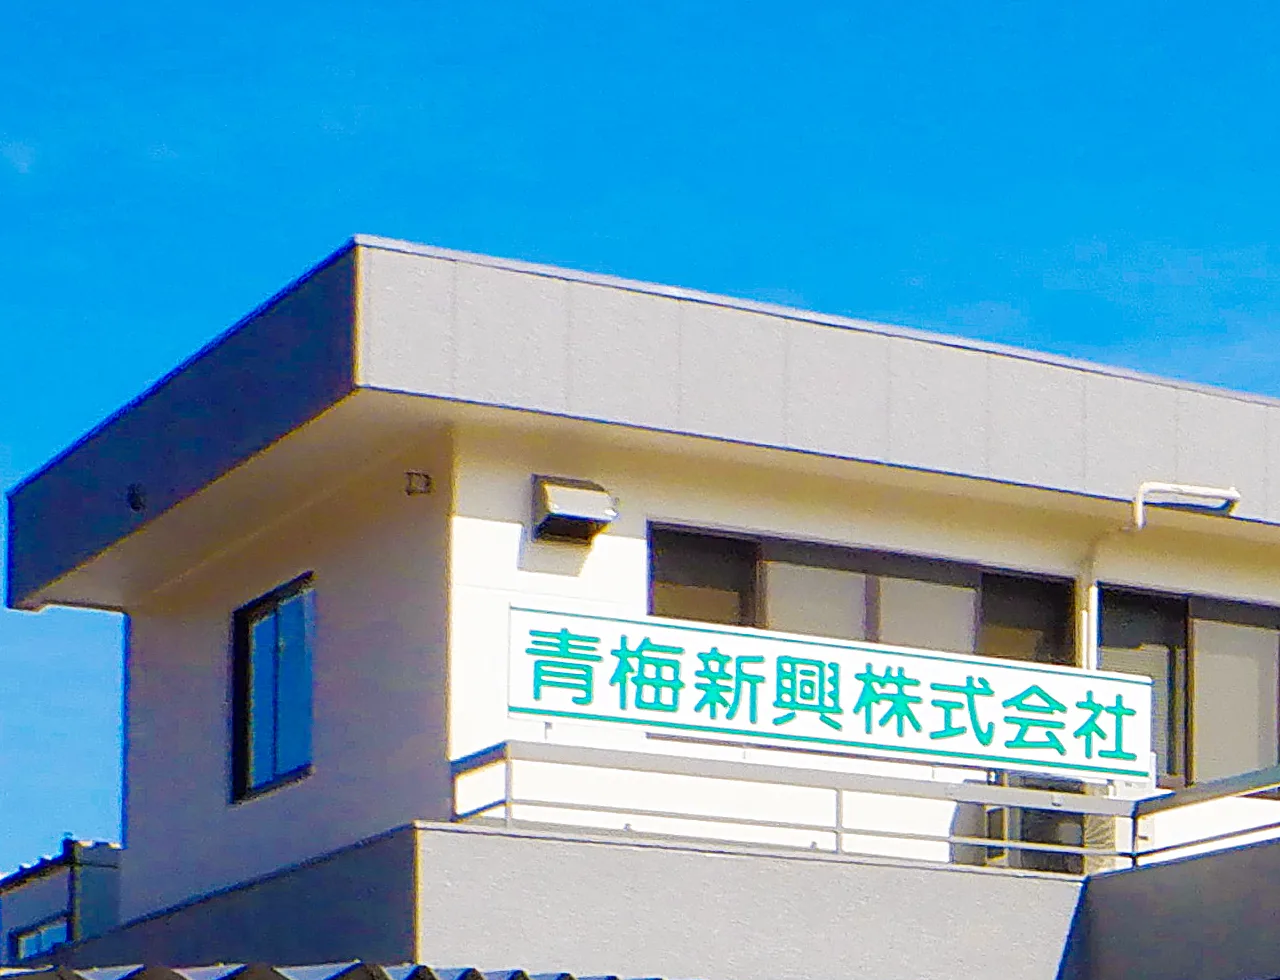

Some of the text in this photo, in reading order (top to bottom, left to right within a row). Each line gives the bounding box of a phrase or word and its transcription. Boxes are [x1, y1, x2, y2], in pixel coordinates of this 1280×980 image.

[525, 628, 1138, 762] 青梅新興株式会社
